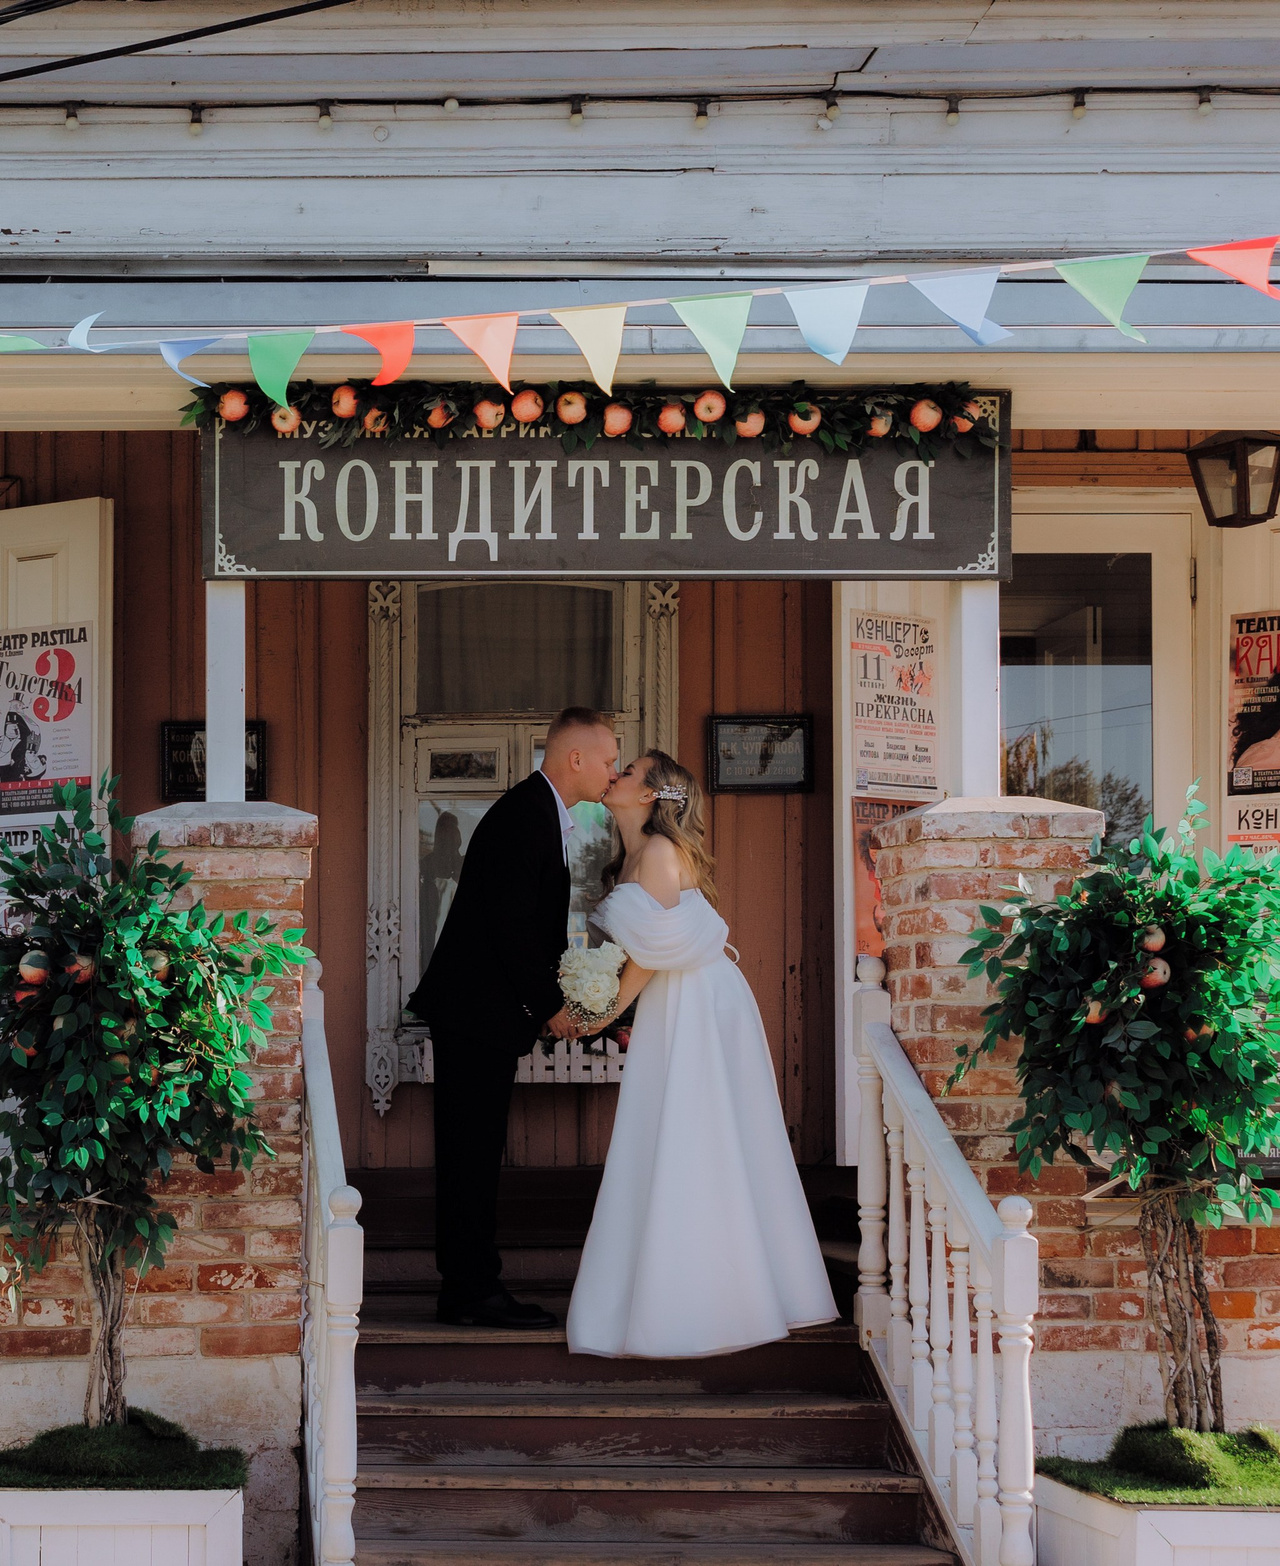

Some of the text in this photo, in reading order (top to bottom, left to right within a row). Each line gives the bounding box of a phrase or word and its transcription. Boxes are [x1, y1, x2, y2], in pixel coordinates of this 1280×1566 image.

[278, 459, 936, 562] КОНДИТЕРСКАЯ
[31, 627, 87, 647] PASTILA
[856, 617, 919, 644] КОНЦЕРТ
[894, 644, 934, 660] Десерт
[860, 653, 884, 681] 11
[32, 648, 76, 722] 3
[855, 702, 934, 724] ПРЕКРАСНА
[742, 741, 801, 755] ЧУПРИКОВА
[855, 802, 889, 819] ТЕАТР
